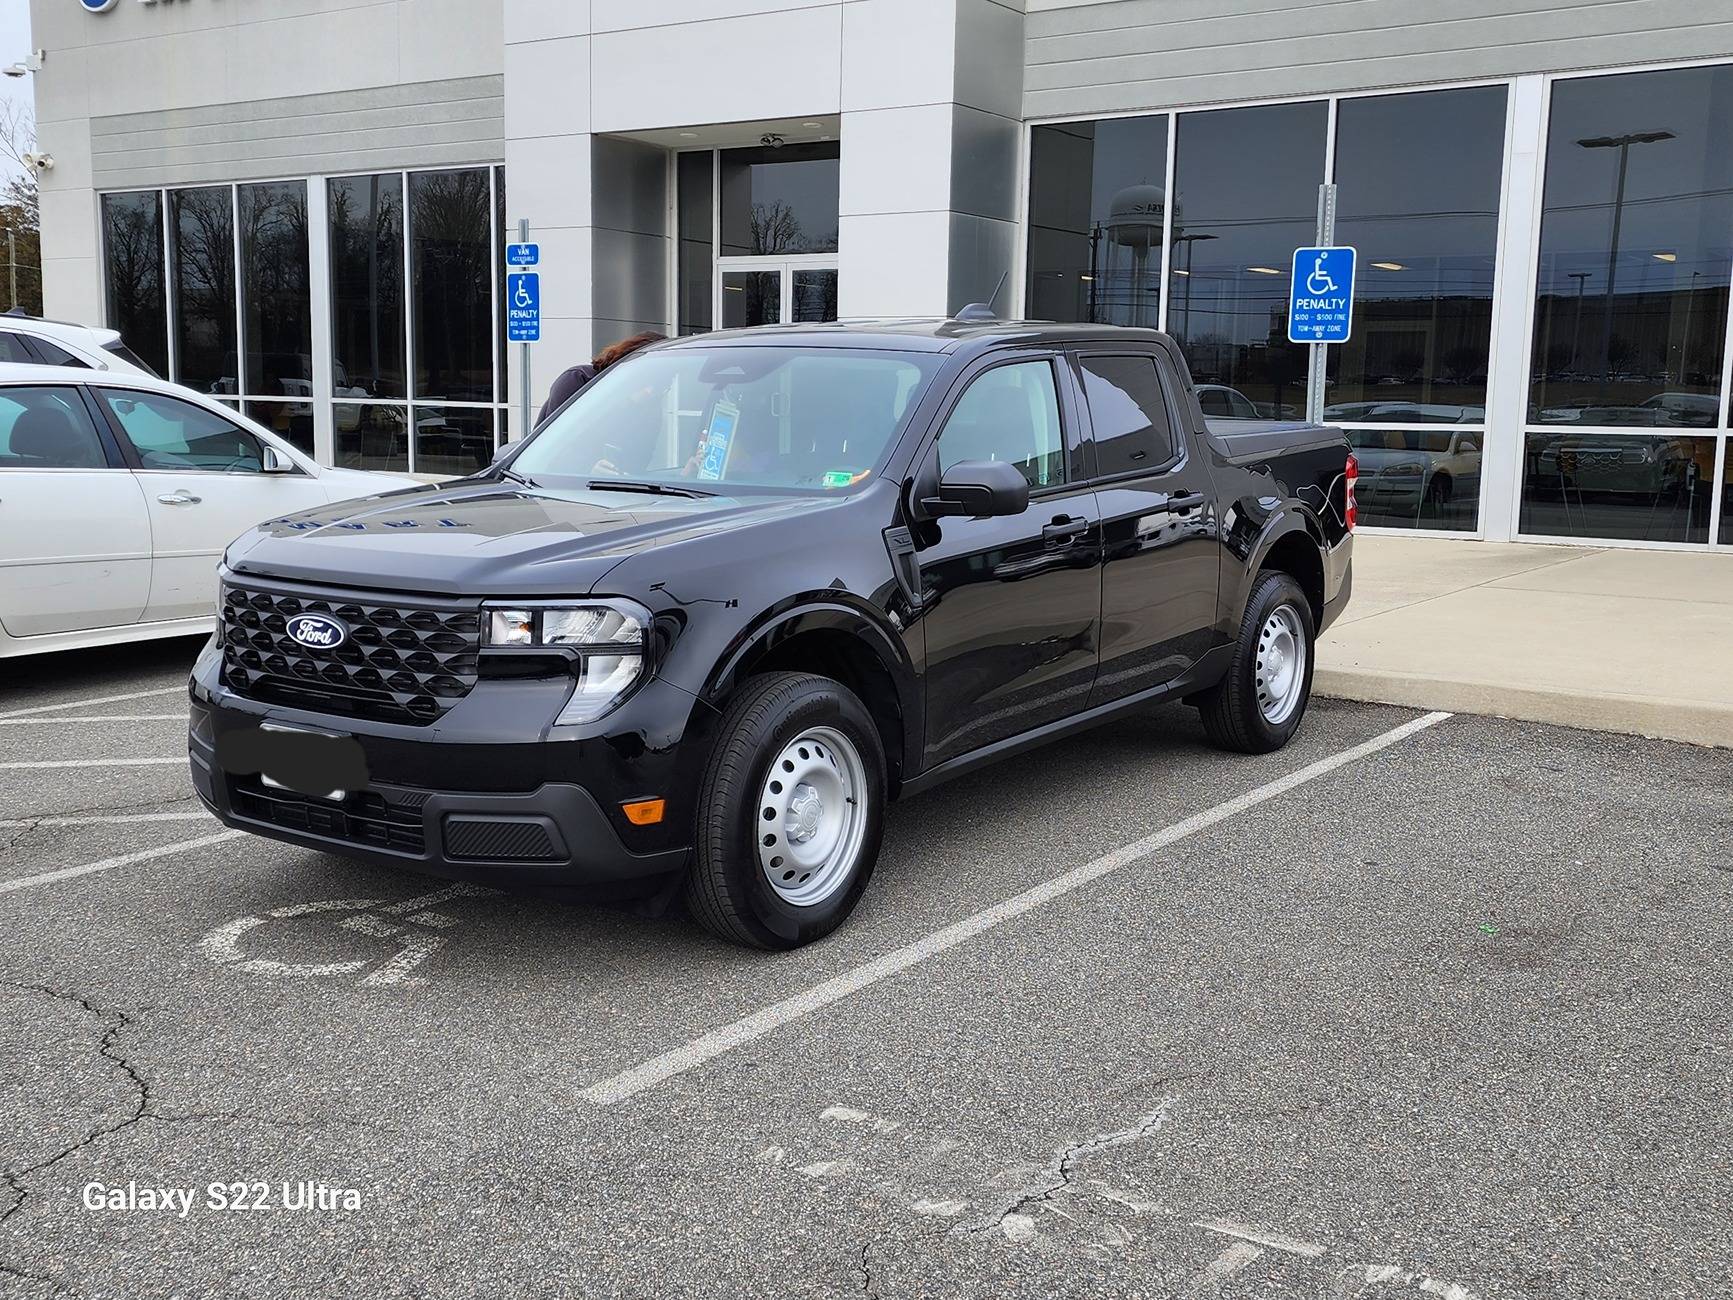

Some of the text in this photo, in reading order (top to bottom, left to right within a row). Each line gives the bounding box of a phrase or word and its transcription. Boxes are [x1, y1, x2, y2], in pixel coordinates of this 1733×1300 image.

[517, 248, 530, 256] VAN
[1296, 298, 1346, 310] PENALTY
[510, 309, 538, 318] PENALTY
[296, 619, 333, 645] Ford
